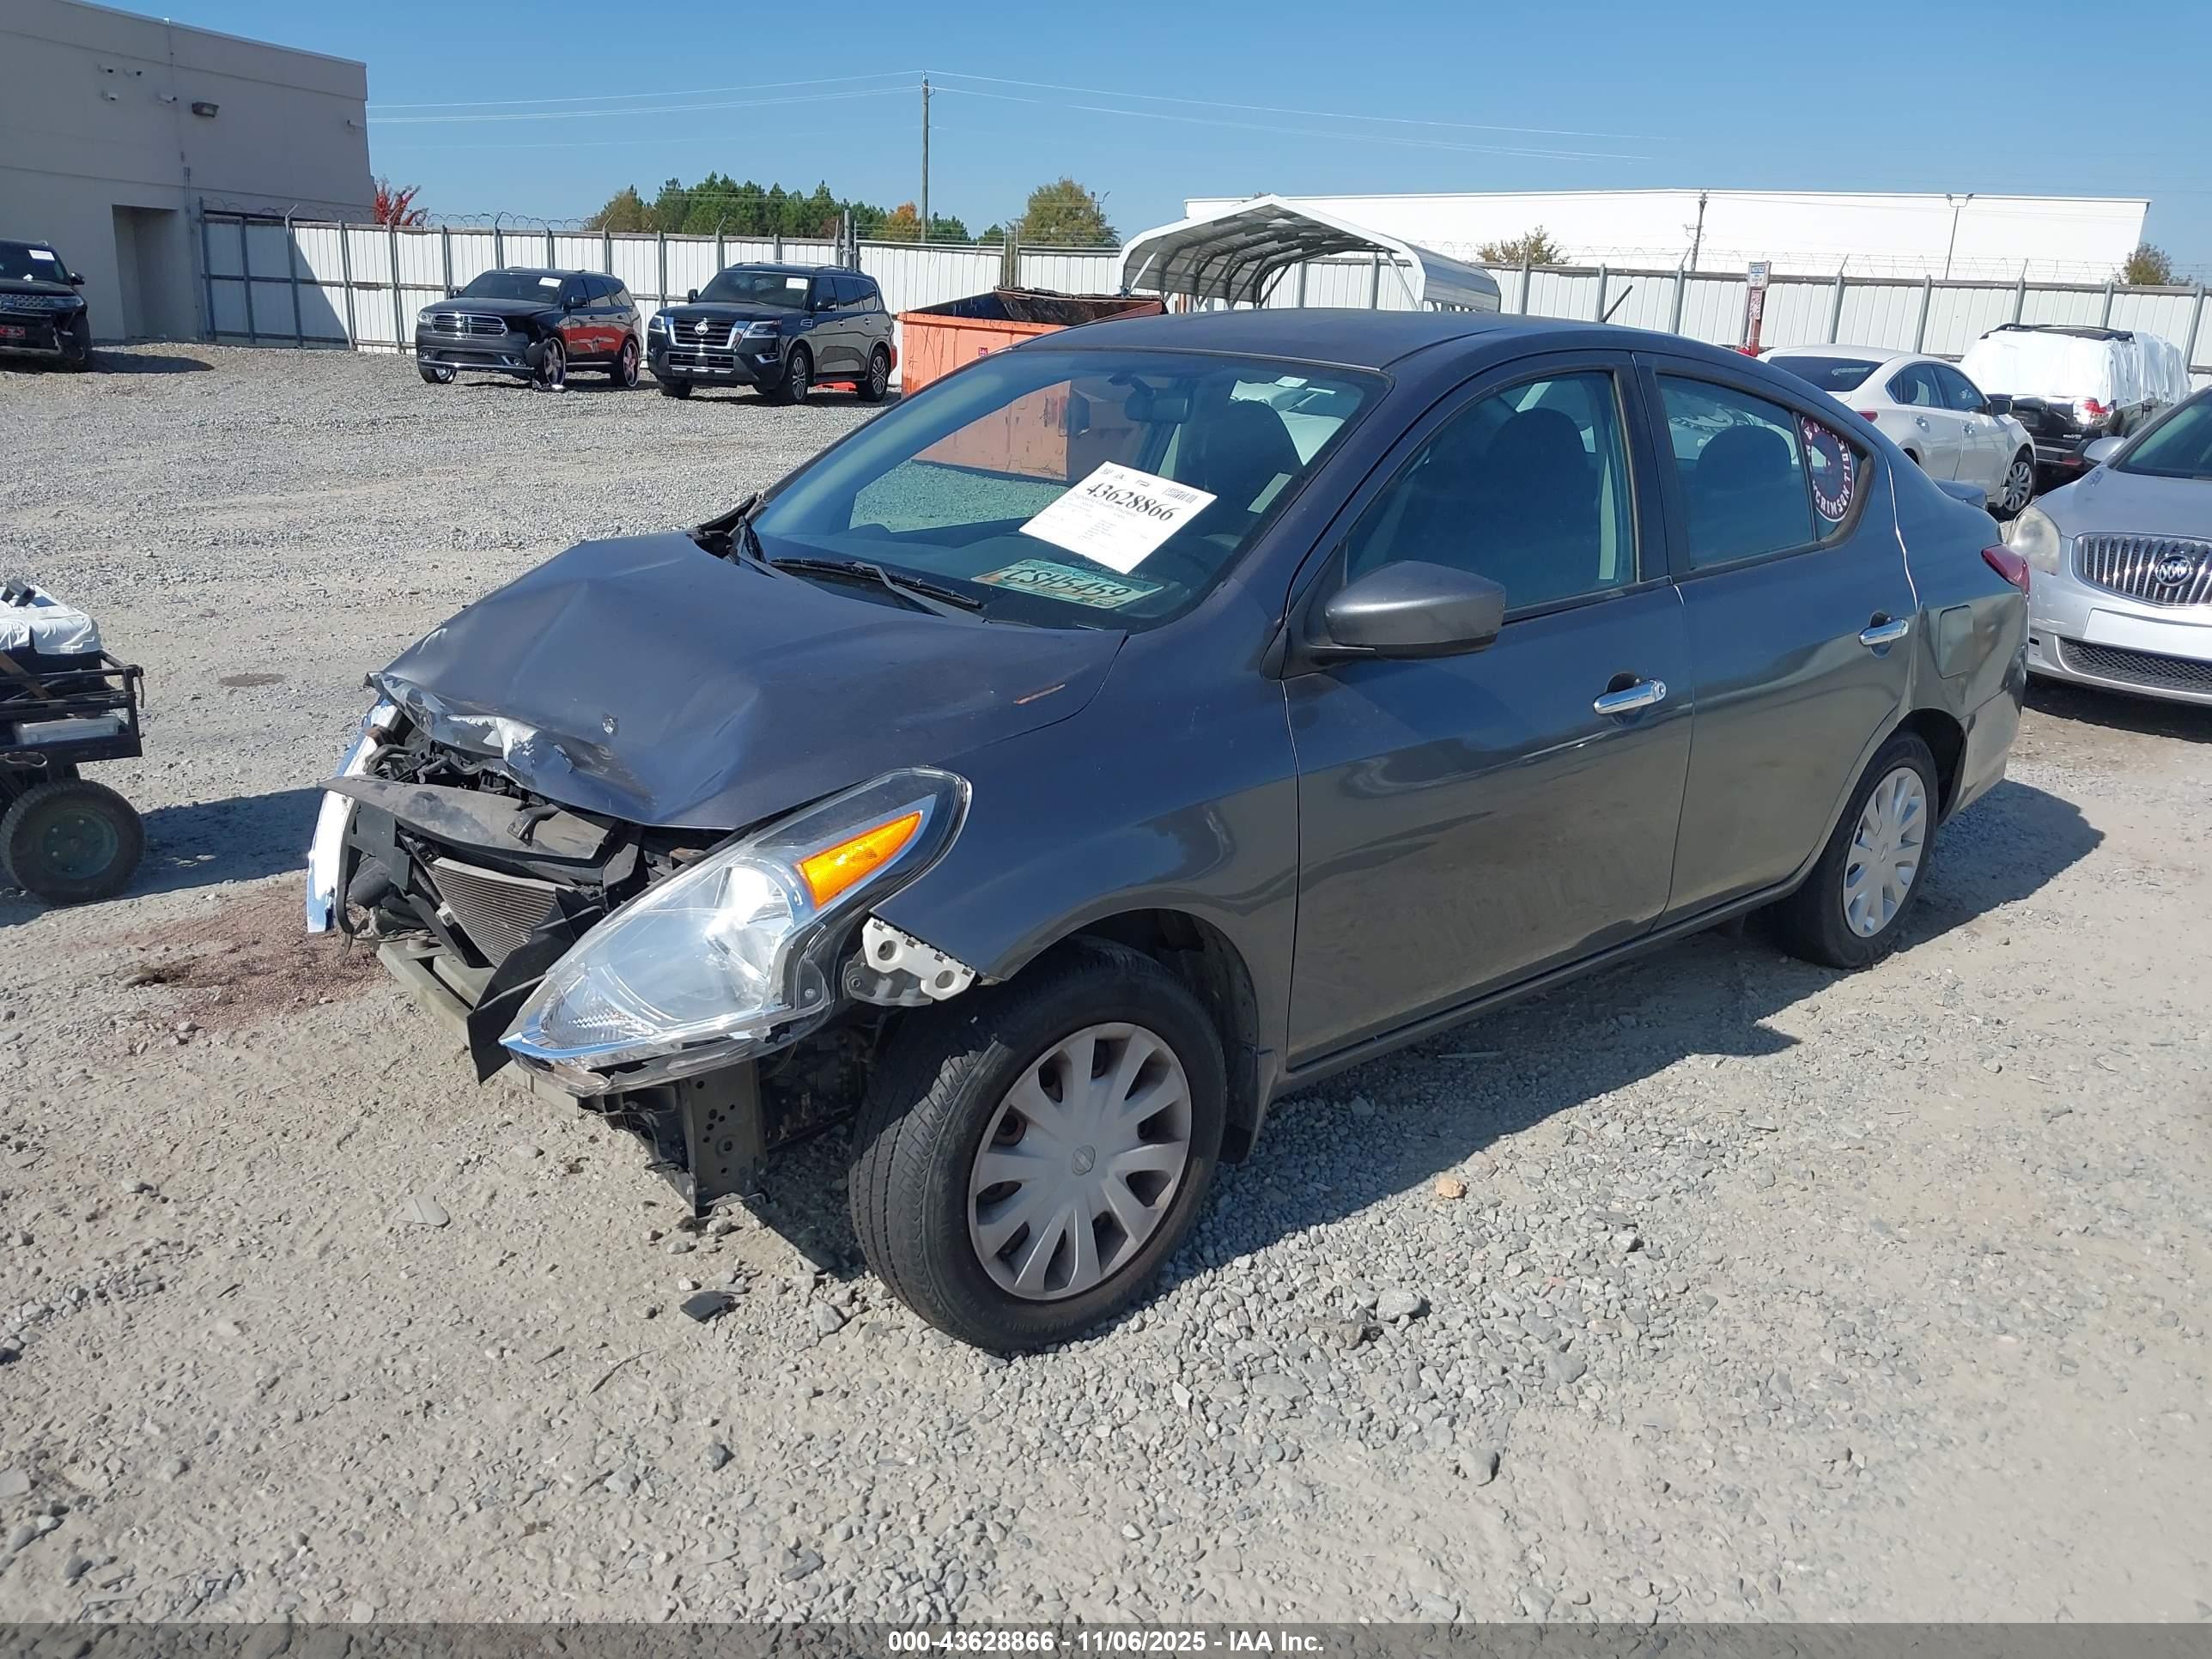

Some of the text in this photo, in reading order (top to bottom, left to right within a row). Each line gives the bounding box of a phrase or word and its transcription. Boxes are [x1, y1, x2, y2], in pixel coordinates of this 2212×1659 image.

[1814, 440, 1852, 516] CRIMSON TIDE
[1086, 482, 1182, 522] 43628866
[1003, 568, 1133, 599] CSH5459
